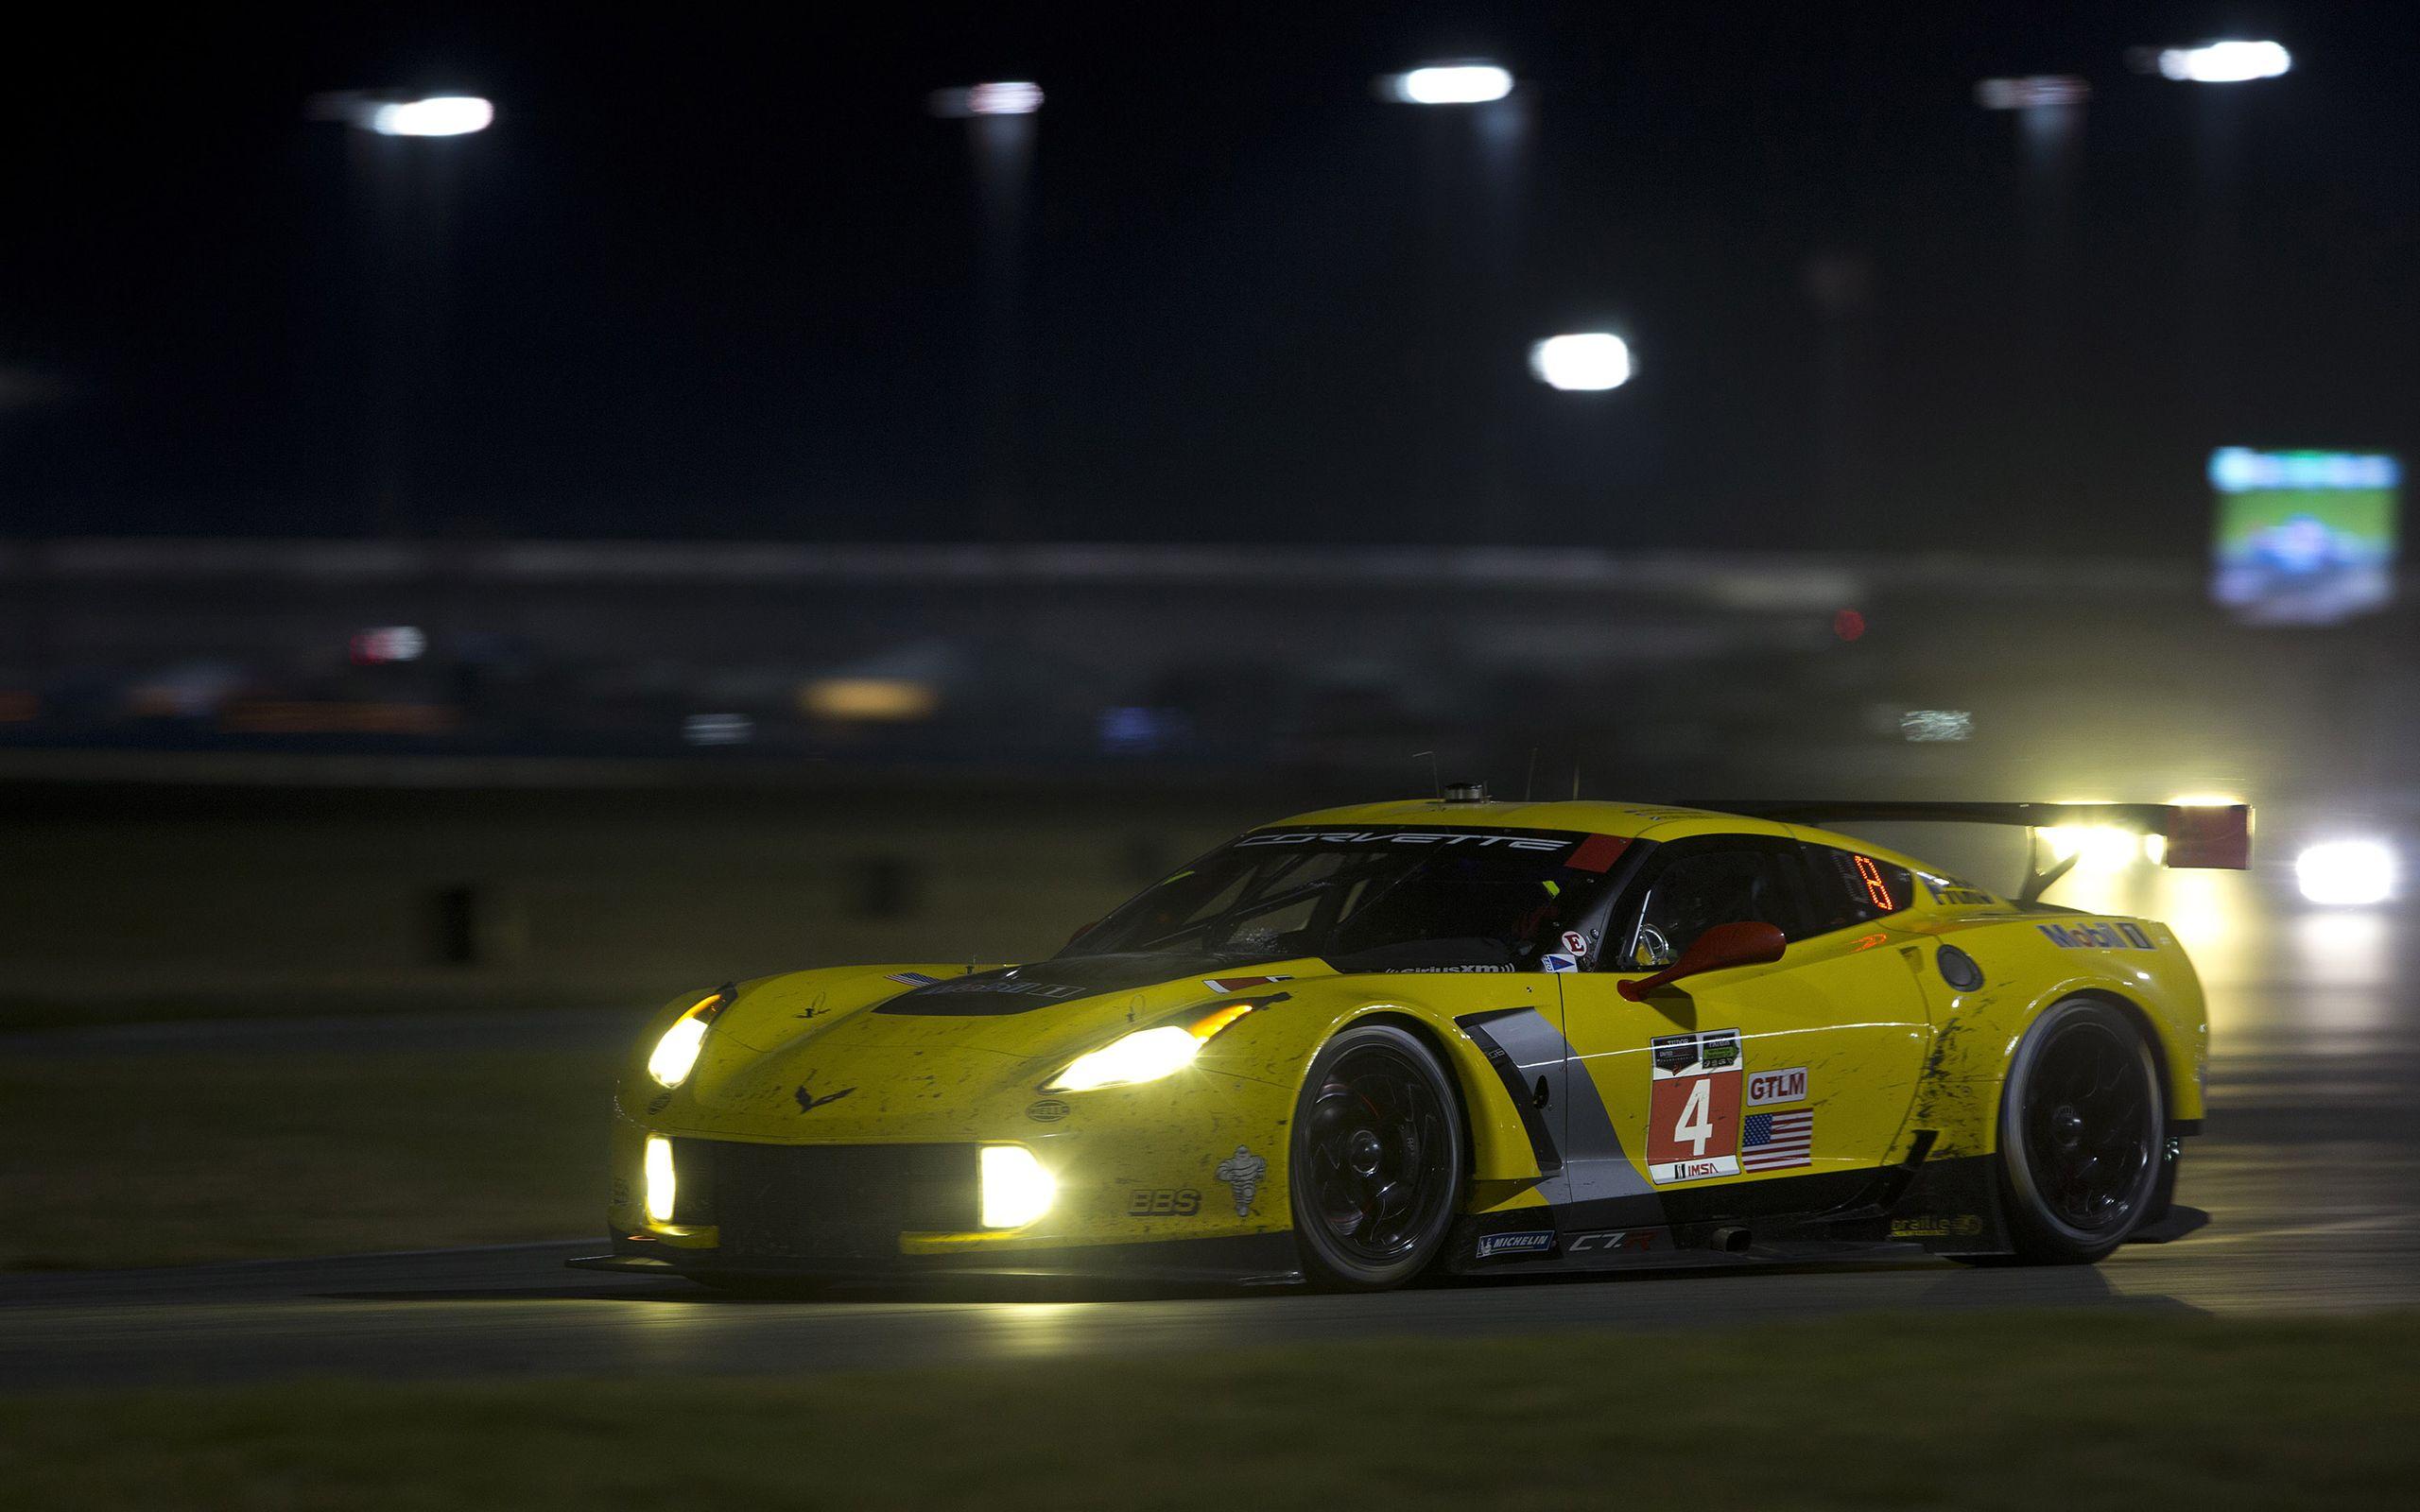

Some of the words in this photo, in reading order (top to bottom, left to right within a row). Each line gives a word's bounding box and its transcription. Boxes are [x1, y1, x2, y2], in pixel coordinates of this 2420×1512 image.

[1233, 832, 1573, 851] CORVETTE
[1564, 935, 1584, 953] E
[2036, 922, 2128, 948] Mobil
[1751, 1073, 1805, 1100] GTLM
[1673, 1078, 1713, 1157] 4
[1688, 1162, 1719, 1177] IMSA
[1128, 1189, 1201, 1216] BBS
[1493, 1233, 1548, 1248] MICHELIN
